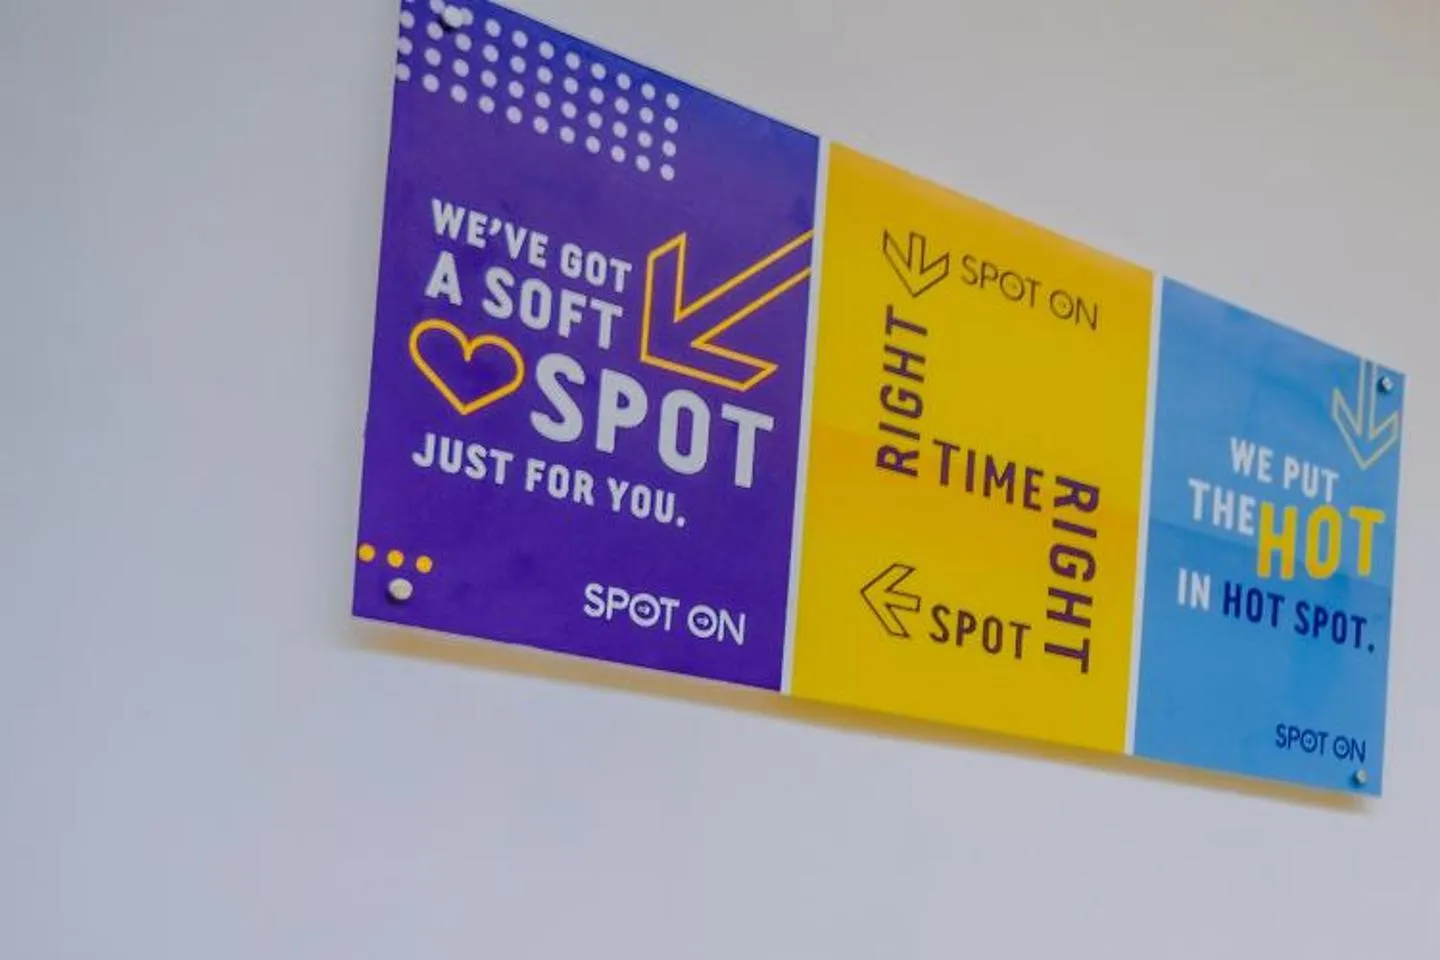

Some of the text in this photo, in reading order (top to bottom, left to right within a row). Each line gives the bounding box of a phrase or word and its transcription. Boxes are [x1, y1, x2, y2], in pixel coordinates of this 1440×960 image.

[431, 198, 633, 293] WE'VE GOT
[425, 250, 624, 350] A SOFT
[961, 254, 1098, 331] SPOT ON
[530, 352, 775, 489] SPOT
[874, 303, 928, 480] RIGHT
[412, 433, 686, 527] JUST FOR YOU.
[932, 438, 1044, 513] TIME
[1229, 437, 1339, 503] WE PUT
[1189, 478, 1385, 581] THE HOT
[583, 583, 746, 646] SPOT ON
[1043, 475, 1101, 675] RIGHT
[1177, 567, 1375, 654] IN HOT SPOT.
[928, 603, 1033, 660] SPOT
[1275, 723, 1366, 764] SPOT ON
